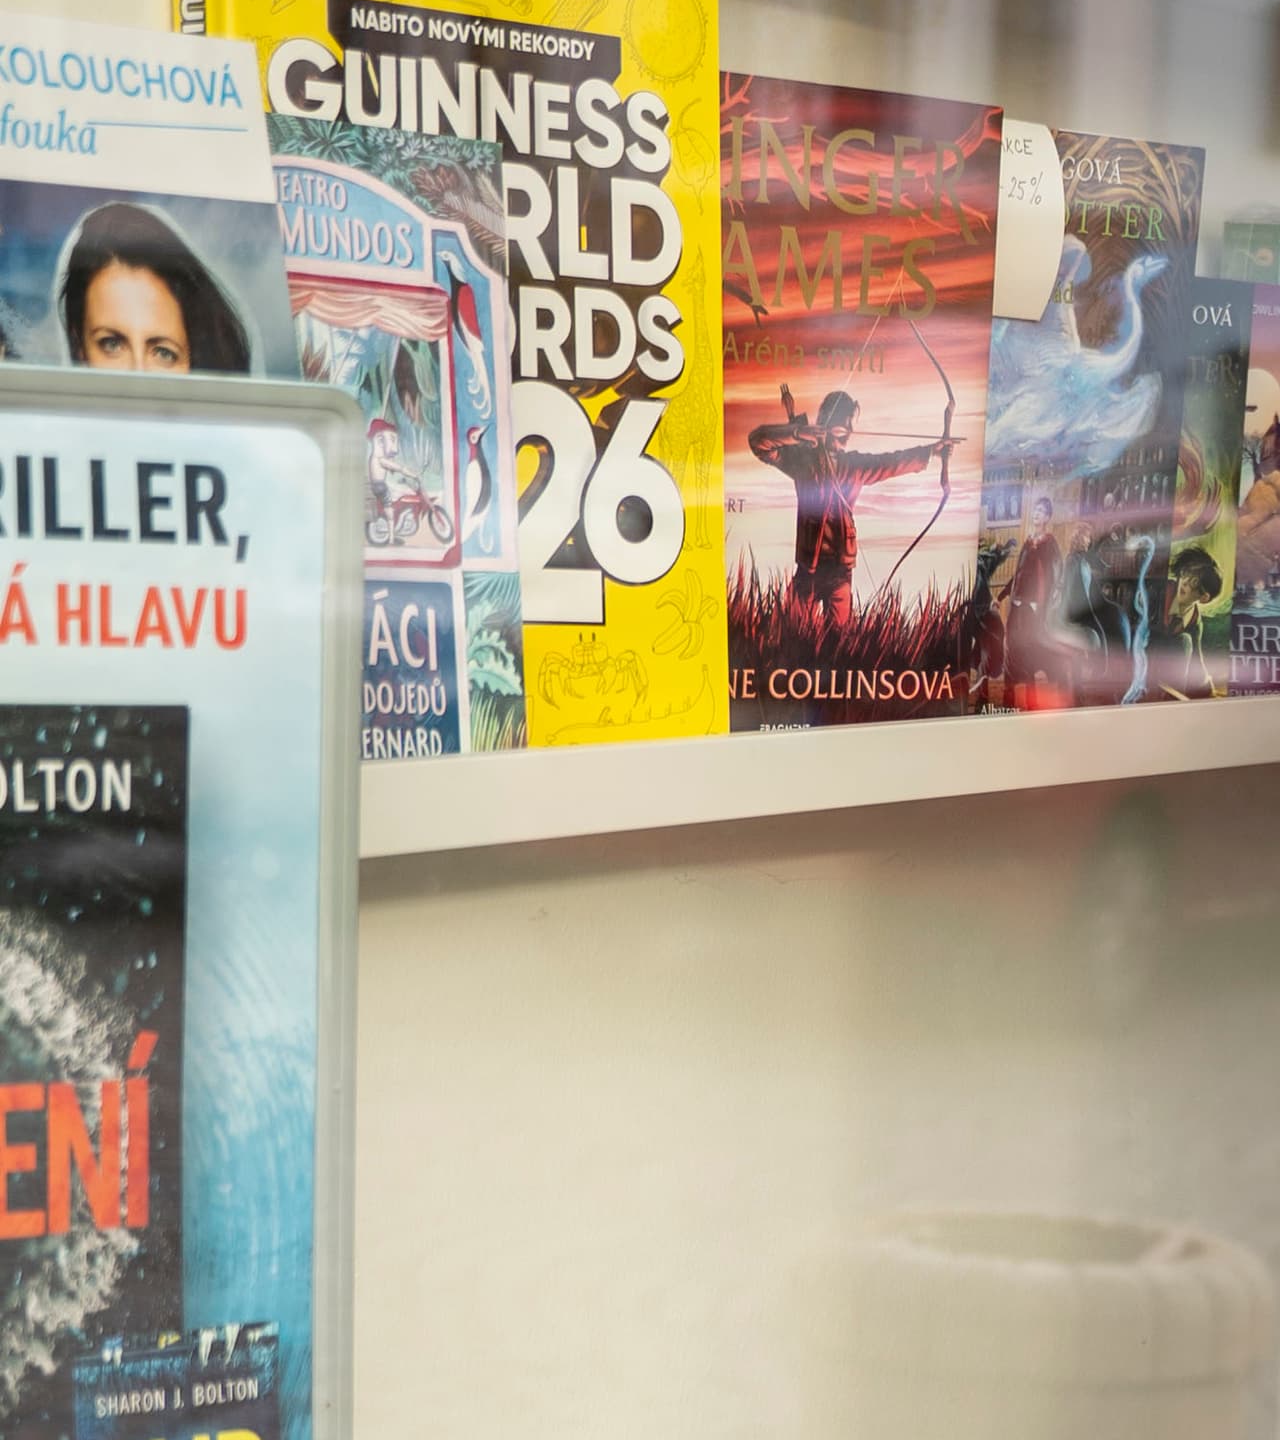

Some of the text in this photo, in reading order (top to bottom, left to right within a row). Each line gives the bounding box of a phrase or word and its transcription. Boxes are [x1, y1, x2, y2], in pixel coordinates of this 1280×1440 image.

[352, 6, 596, 63] NABITO NOVÝMI REKORDY
[267, 37, 672, 174] GUINNESS
[280, 202, 414, 269] MUNDOS
[722, 331, 805, 370] Aréna
[57, 583, 248, 651] HLAVU
[768, 663, 954, 701] COLLINSOVÁ
[361, 727, 442, 758] ERNARD
[96, 1388, 167, 1419] SHARON
[194, 1378, 259, 1407] BOLTON
